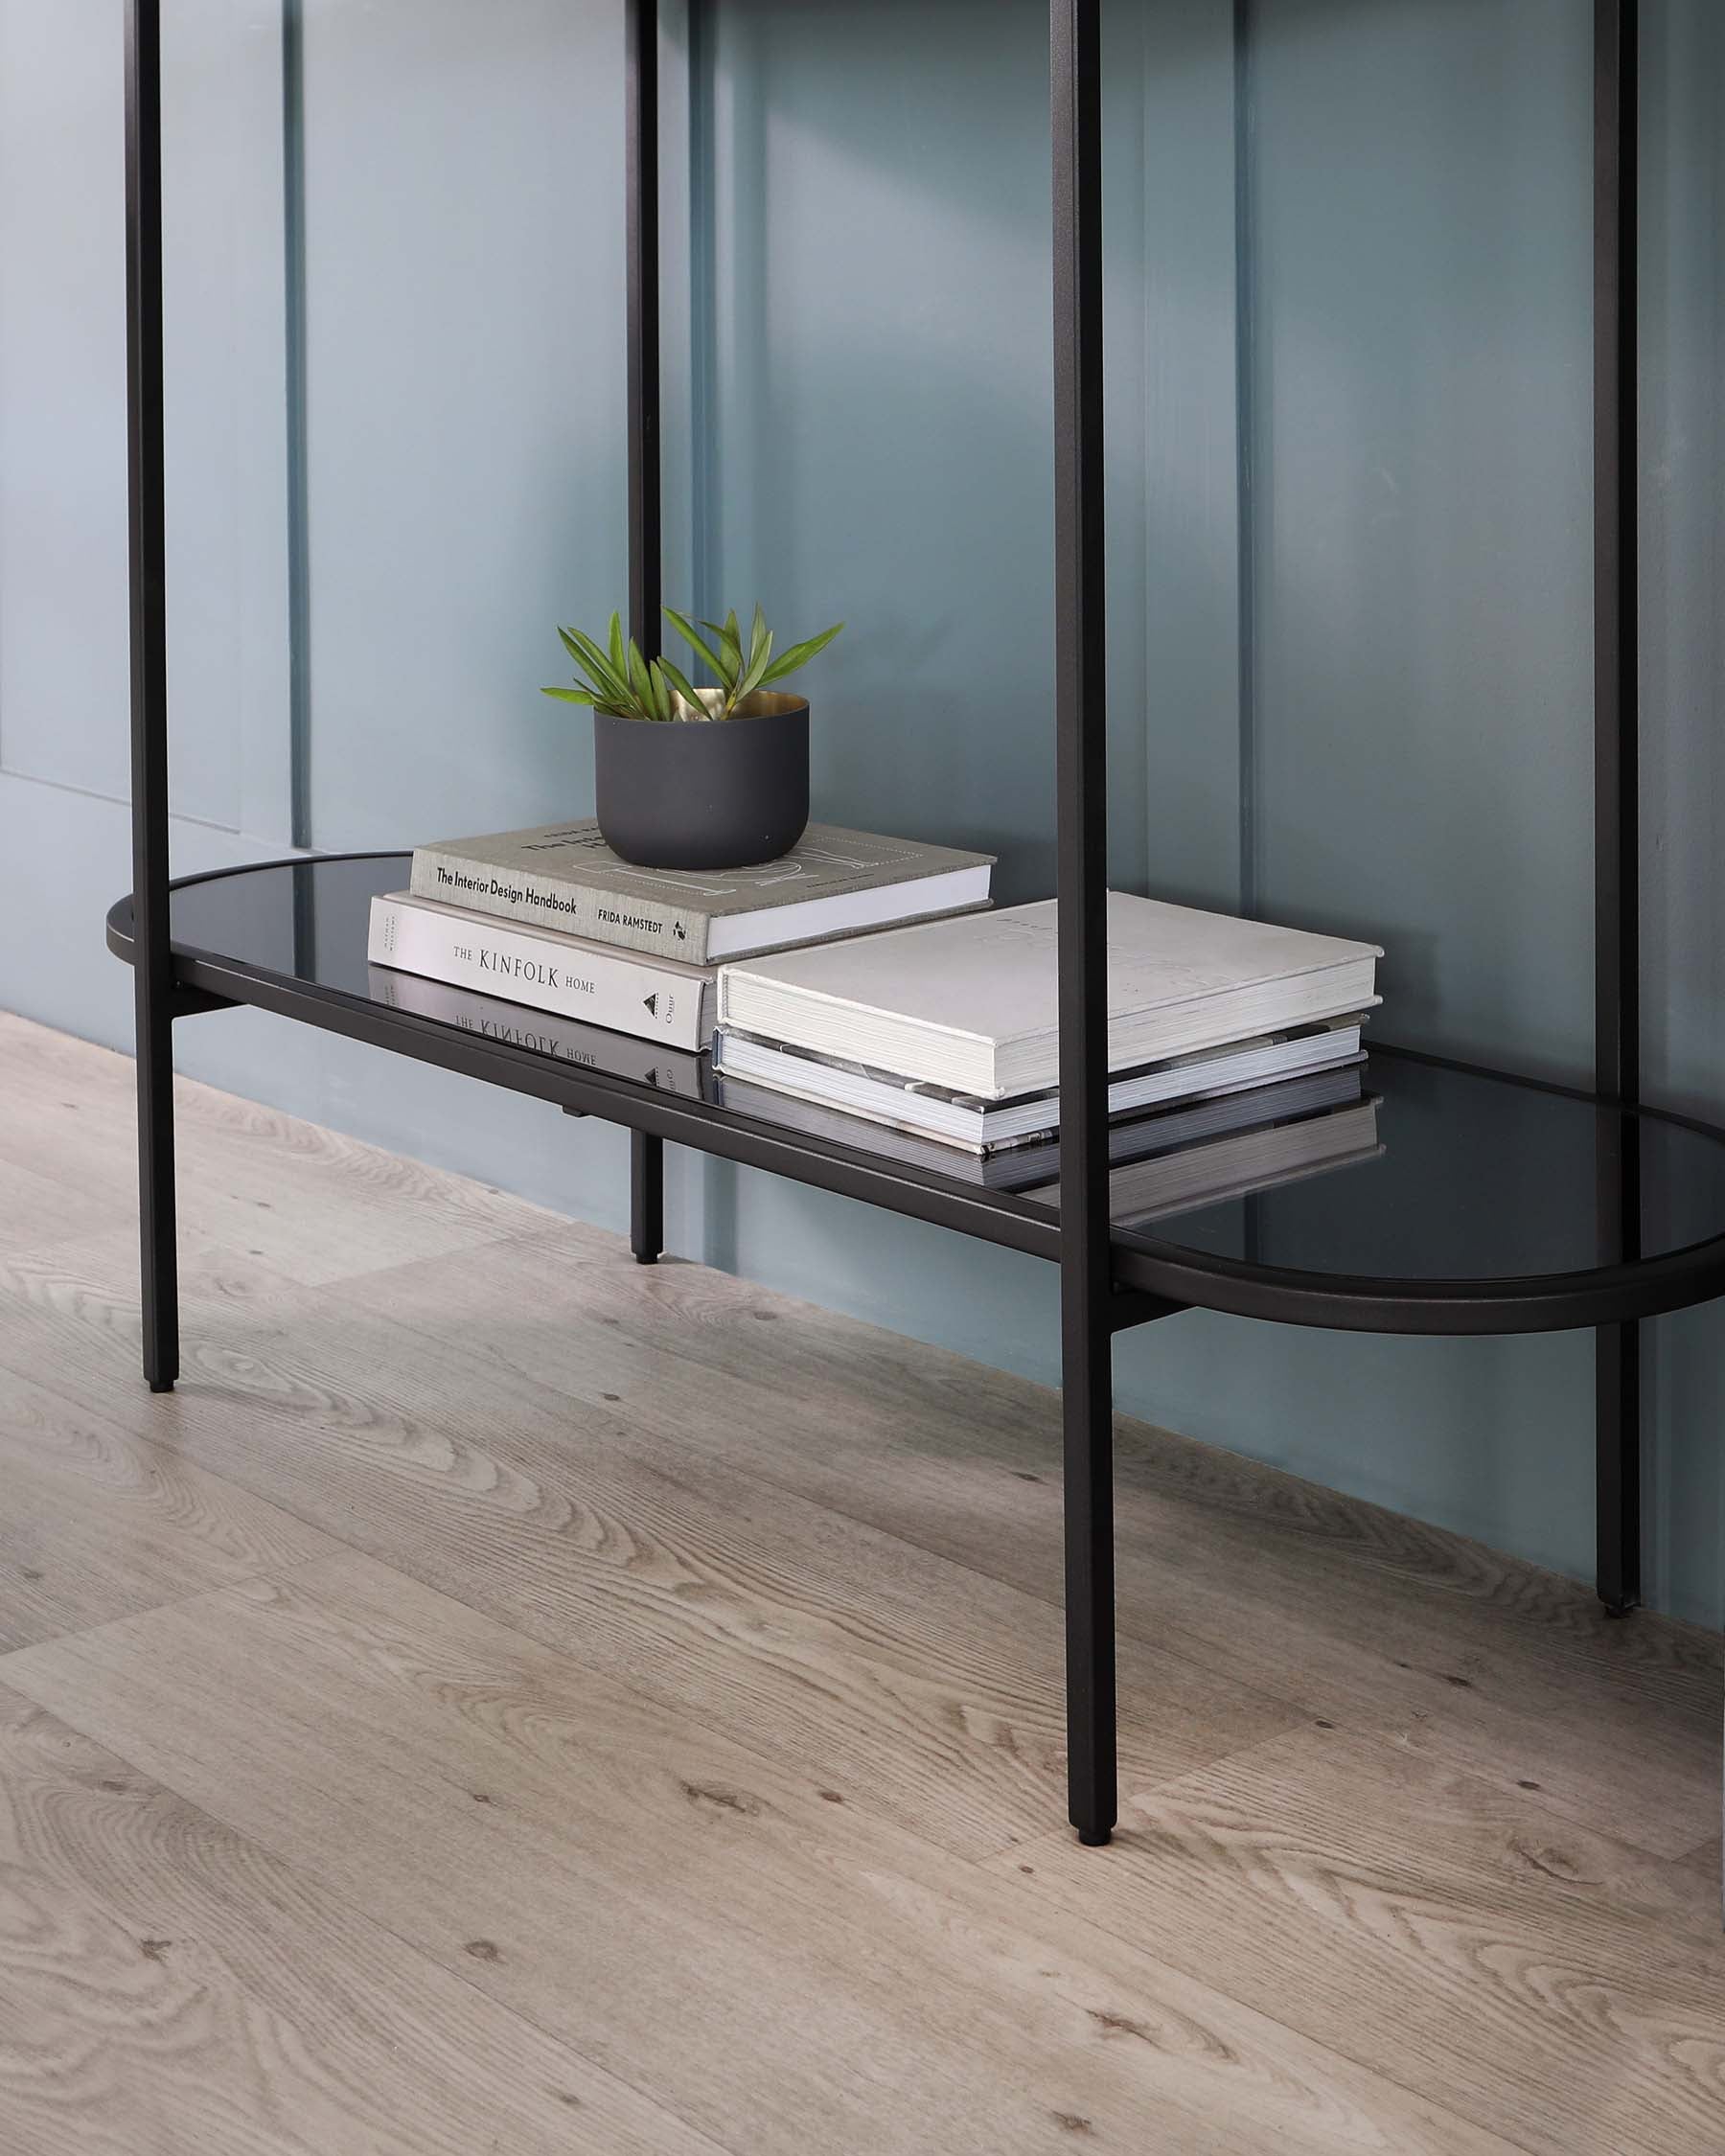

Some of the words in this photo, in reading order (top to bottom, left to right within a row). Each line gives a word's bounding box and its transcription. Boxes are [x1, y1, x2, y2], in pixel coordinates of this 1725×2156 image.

[437, 866, 453, 885] The
[454, 871, 489, 894] Interior
[490, 880, 523, 904] Design
[525, 887, 577, 915] Handbook
[598, 908, 621, 925] FRIDA
[622, 914, 663, 934] RAMSTEDT
[453, 946, 472, 960] THE
[479, 949, 559, 988] KINFOLK
[565, 975, 595, 994] HOME
